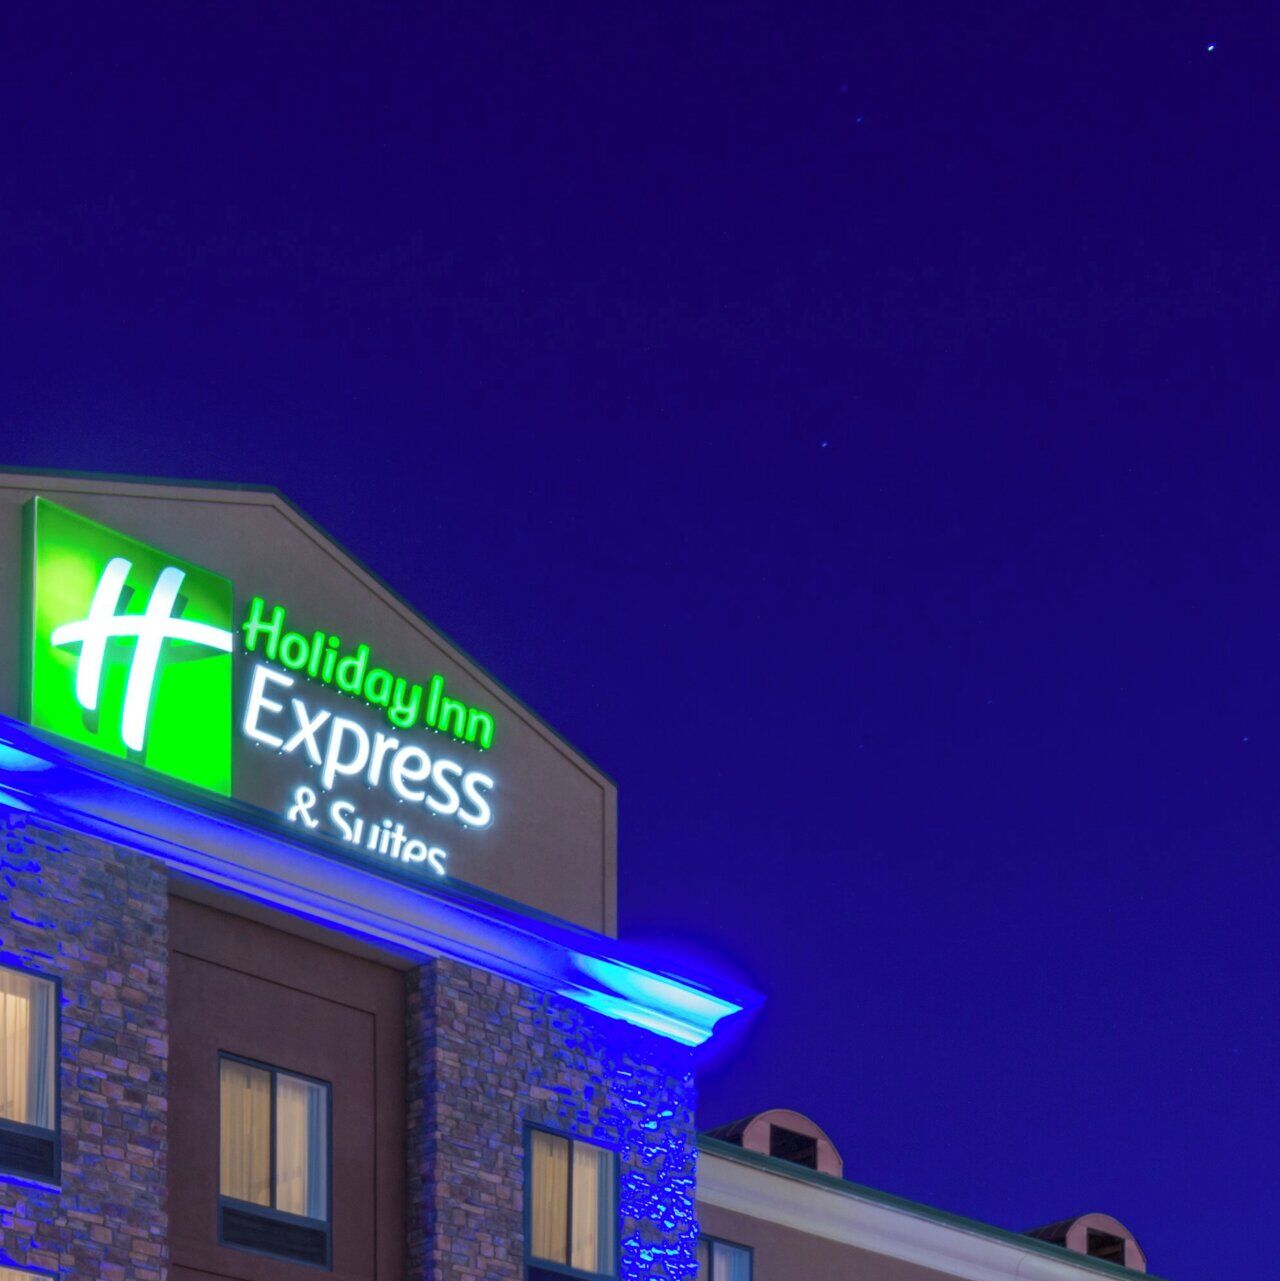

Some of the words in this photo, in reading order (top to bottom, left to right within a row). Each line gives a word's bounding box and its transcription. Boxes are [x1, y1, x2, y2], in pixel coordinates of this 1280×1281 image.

[242, 597, 422, 728] Holiday
[425, 673, 495, 749] Inn
[242, 663, 495, 828] Express
[287, 786, 319, 828] &
[330, 801, 447, 875] Suites
